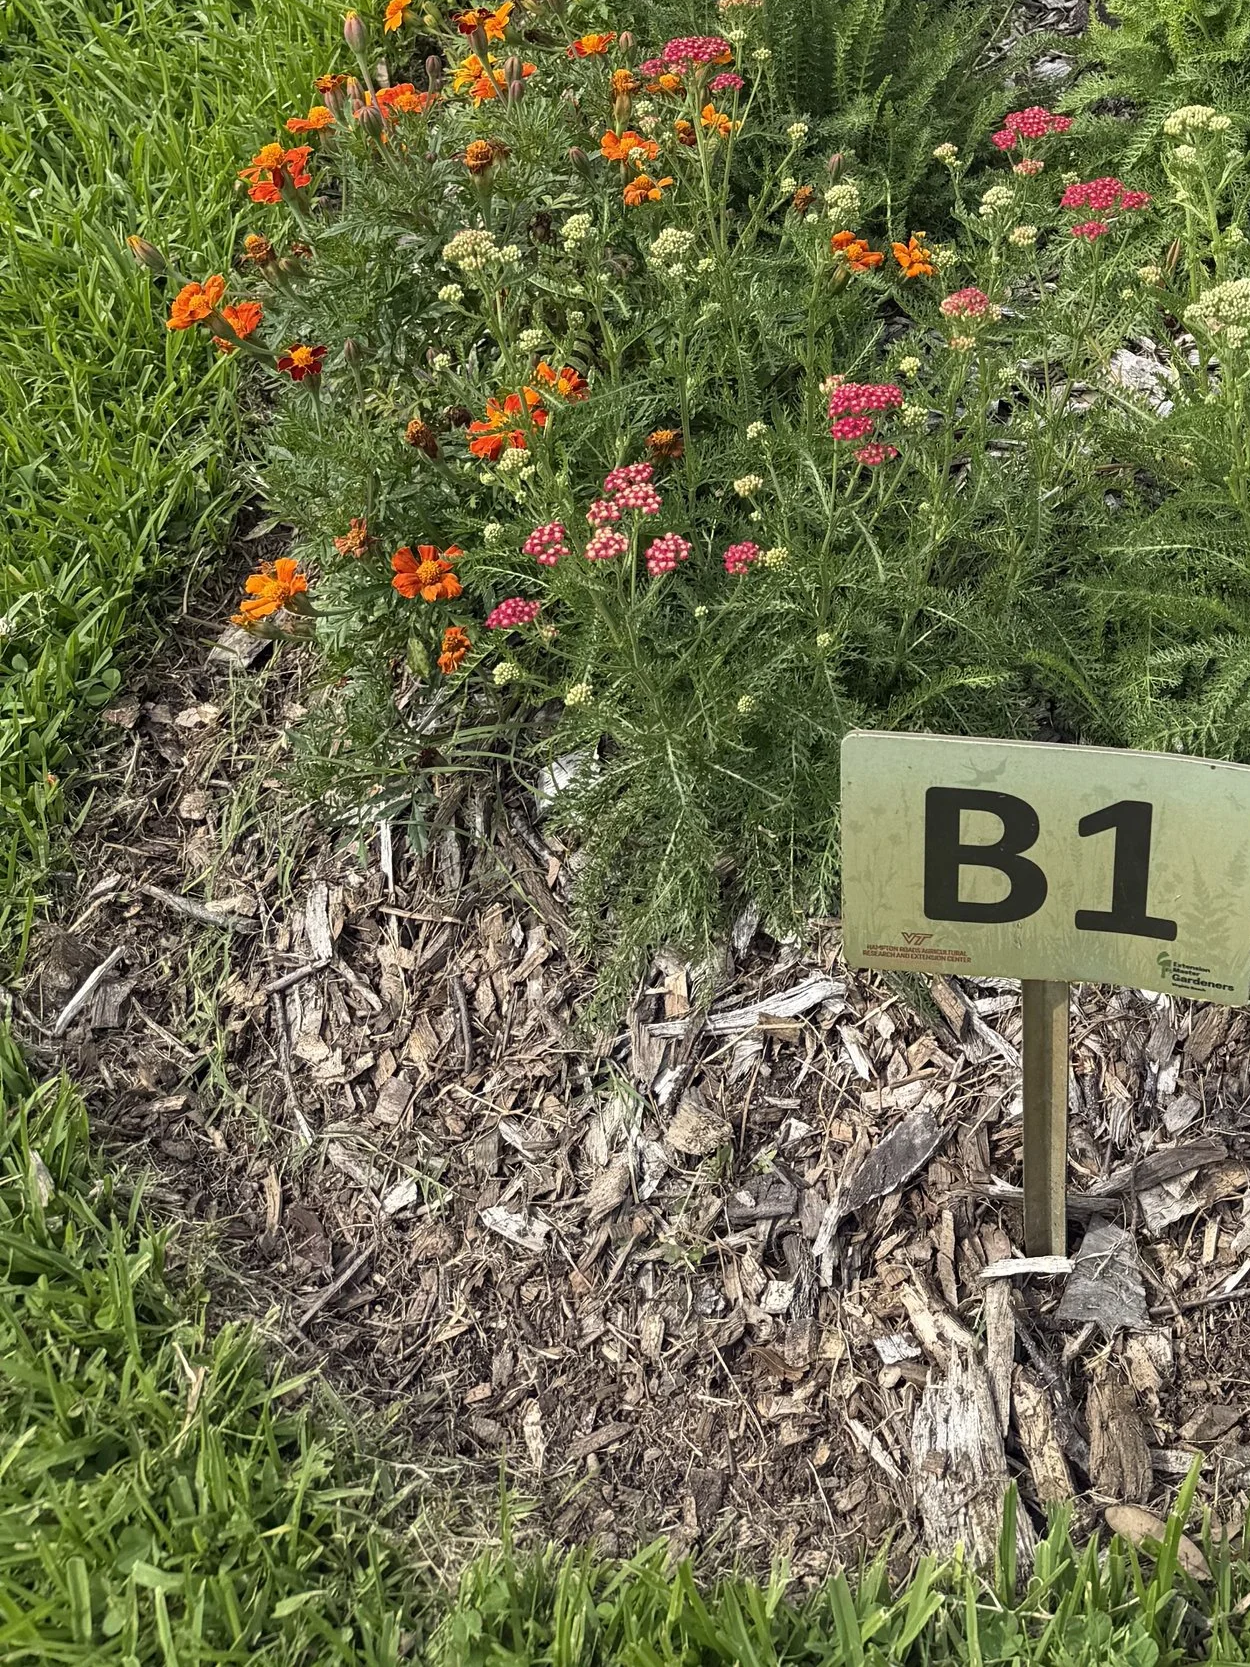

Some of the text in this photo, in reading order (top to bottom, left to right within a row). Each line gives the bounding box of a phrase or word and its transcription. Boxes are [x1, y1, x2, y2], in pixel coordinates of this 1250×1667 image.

[923, 786, 1178, 942] B1
[901, 932, 933, 945] VT
[866, 943, 968, 956] HAMPTON ROADS AGRICULTURAL
[862, 950, 896, 958] RESEARCH
[911, 953, 946, 962] EXTENSION
[947, 955, 972, 963] CENTER
[1172, 967, 1201, 977] Master
[1173, 961, 1211, 973] Extension
[1172, 974, 1235, 991] Gardeners
